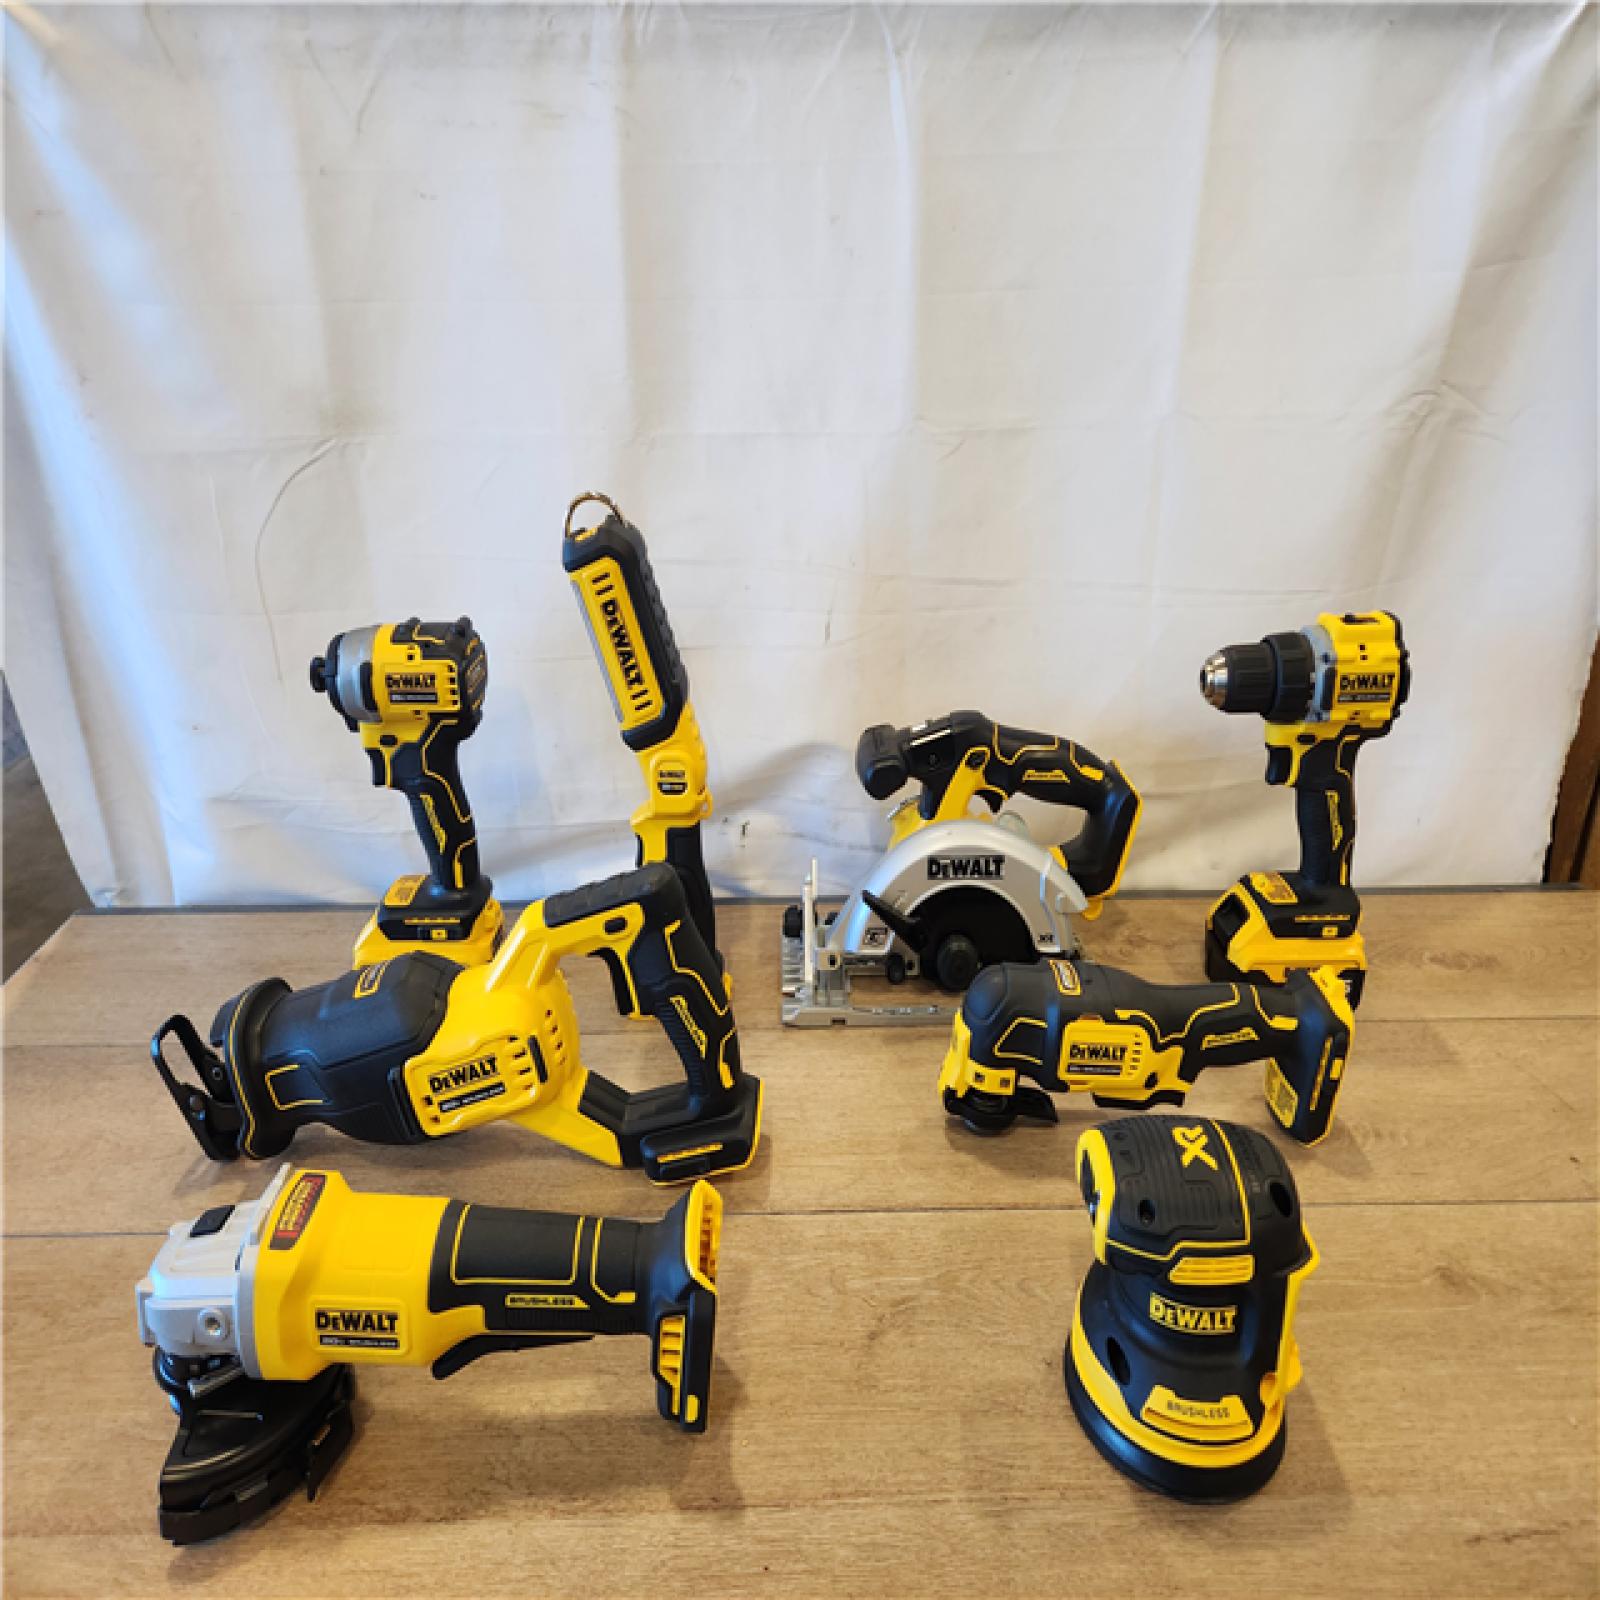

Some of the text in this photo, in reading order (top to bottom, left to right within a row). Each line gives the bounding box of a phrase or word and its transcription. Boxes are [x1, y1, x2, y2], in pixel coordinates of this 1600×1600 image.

[928, 857, 1005, 878] DEWALT
[428, 1054, 498, 1094] DEWALT
[315, 1311, 399, 1333] DEWALT
[1150, 1293, 1237, 1335] DEWALT
